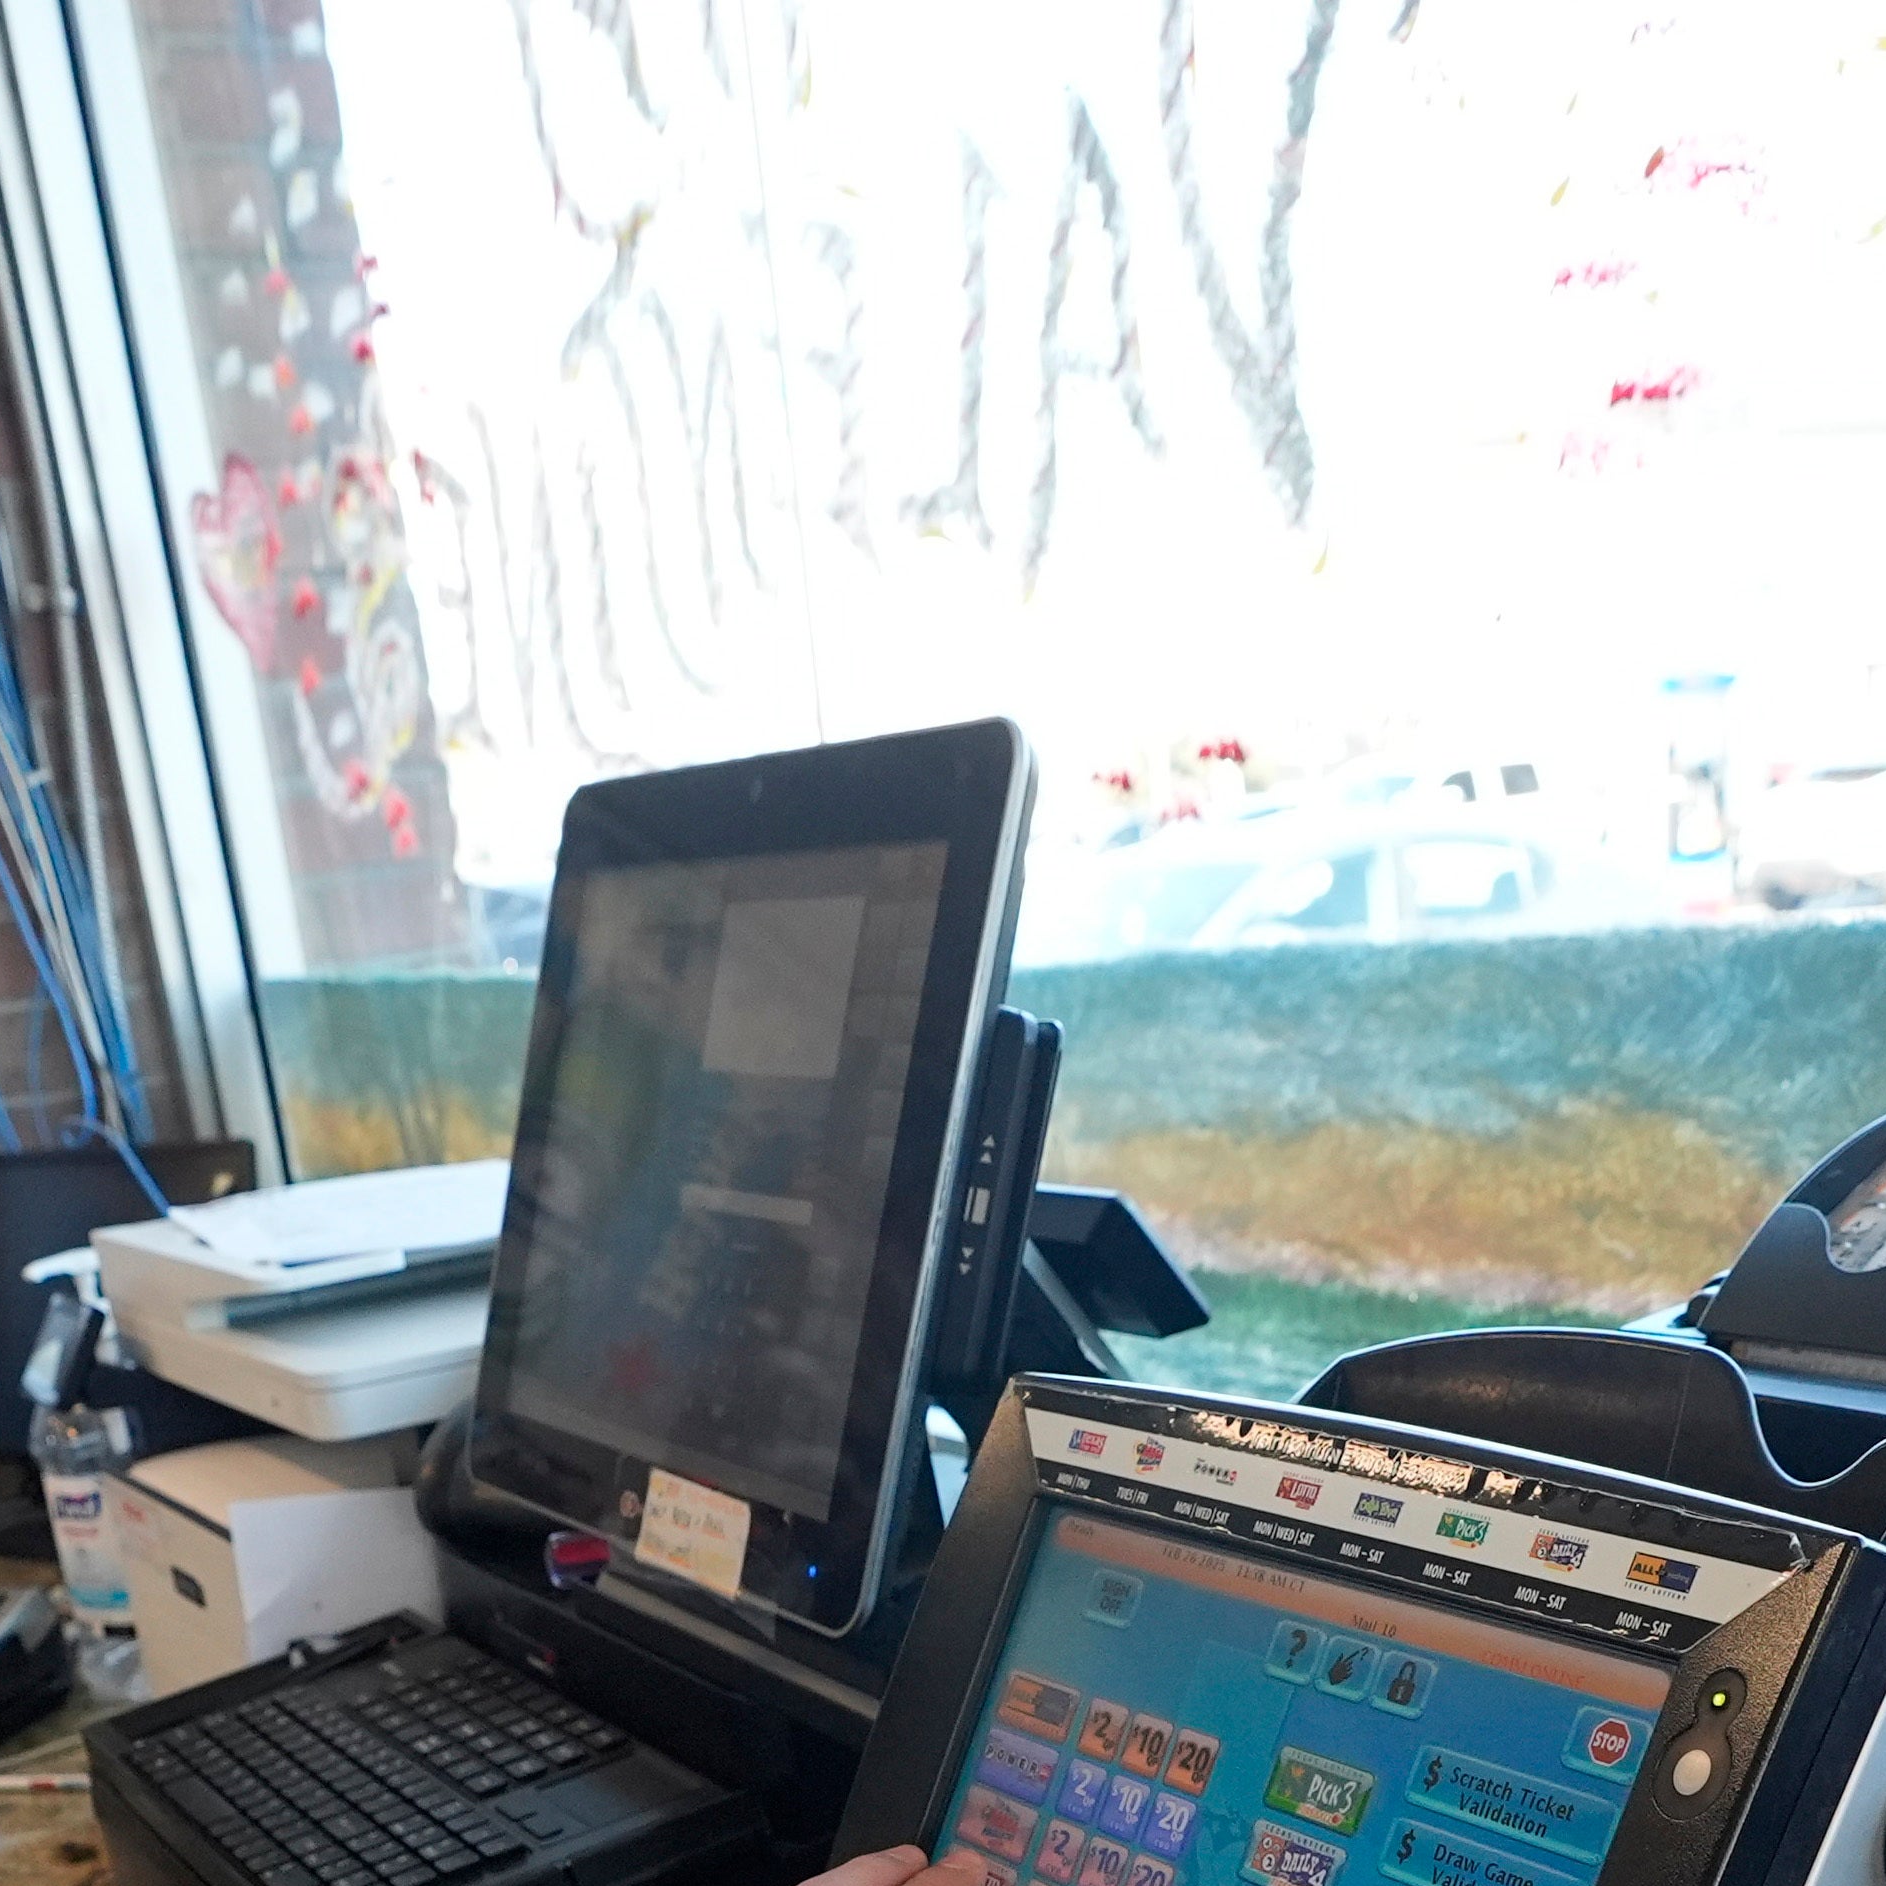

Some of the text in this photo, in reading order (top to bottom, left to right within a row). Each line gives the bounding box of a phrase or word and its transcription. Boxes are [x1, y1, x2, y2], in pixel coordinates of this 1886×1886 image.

[1093, 1710, 1112, 1739] $2
[1134, 1723, 1164, 1755] $10
[1177, 1738, 1211, 1772] $20
[1593, 1730, 1626, 1754] STOP
[1072, 1769, 1091, 1797] $2
[1111, 1783, 1142, 1814] $10
[1307, 1774, 1356, 1814] PICK 3
[1450, 1766, 1576, 1822] Scratch Ticket
[1155, 1798, 1189, 1834] $20
[1457, 1792, 1548, 1838] Validation
[1051, 1822, 1070, 1851] $2
[1088, 1843, 1119, 1871] $10
[1280, 1852, 1320, 1875] DAILY
[1433, 1843, 1480, 1874] Draw
